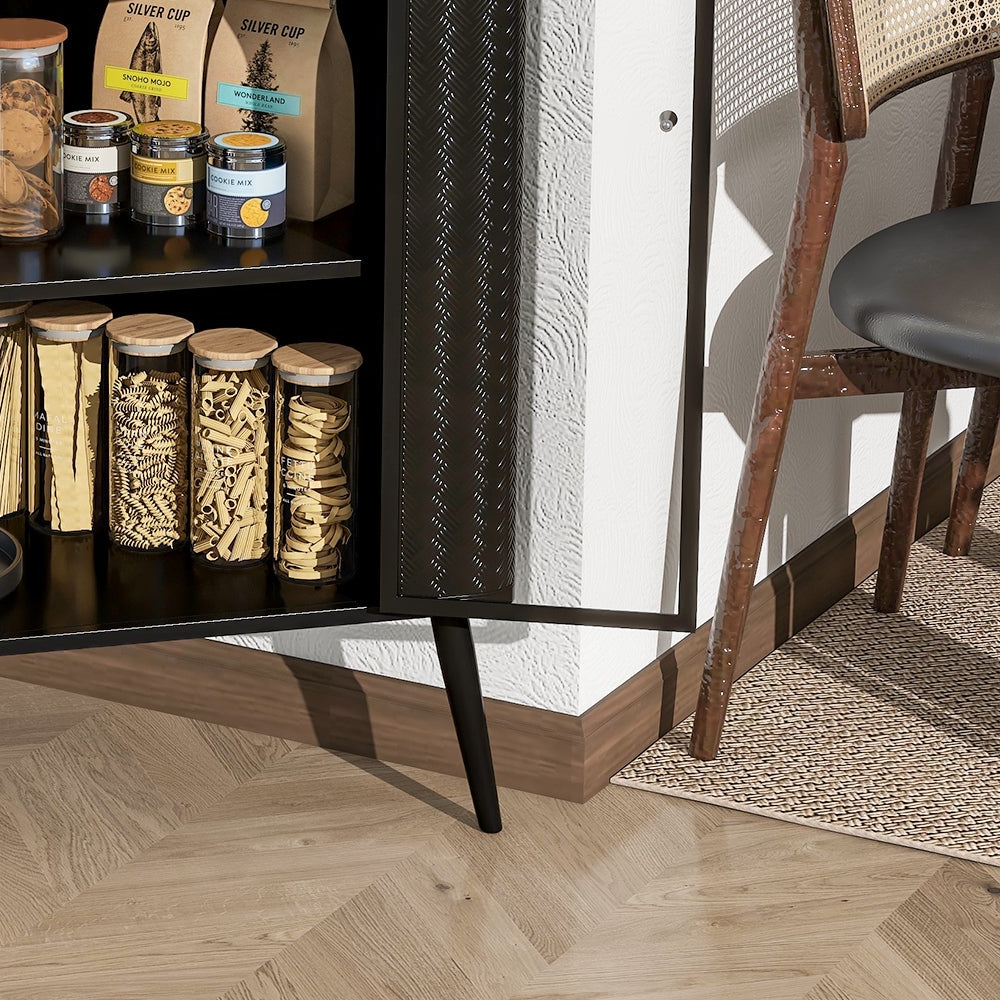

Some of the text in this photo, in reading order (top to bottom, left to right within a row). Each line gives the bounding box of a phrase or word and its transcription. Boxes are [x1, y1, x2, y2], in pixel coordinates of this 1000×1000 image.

[126, 2, 191, 22] SILVER CUP
[240, 18, 305, 39] SILVER CUP
[122, 73, 172, 88] SNOHO MOJO
[233, 90, 286, 105] WONDERLAND
[63, 152, 83, 162] OOKIE
[134, 163, 176, 175] COOKIE MIX
[210, 174, 235, 186] COOKIE
